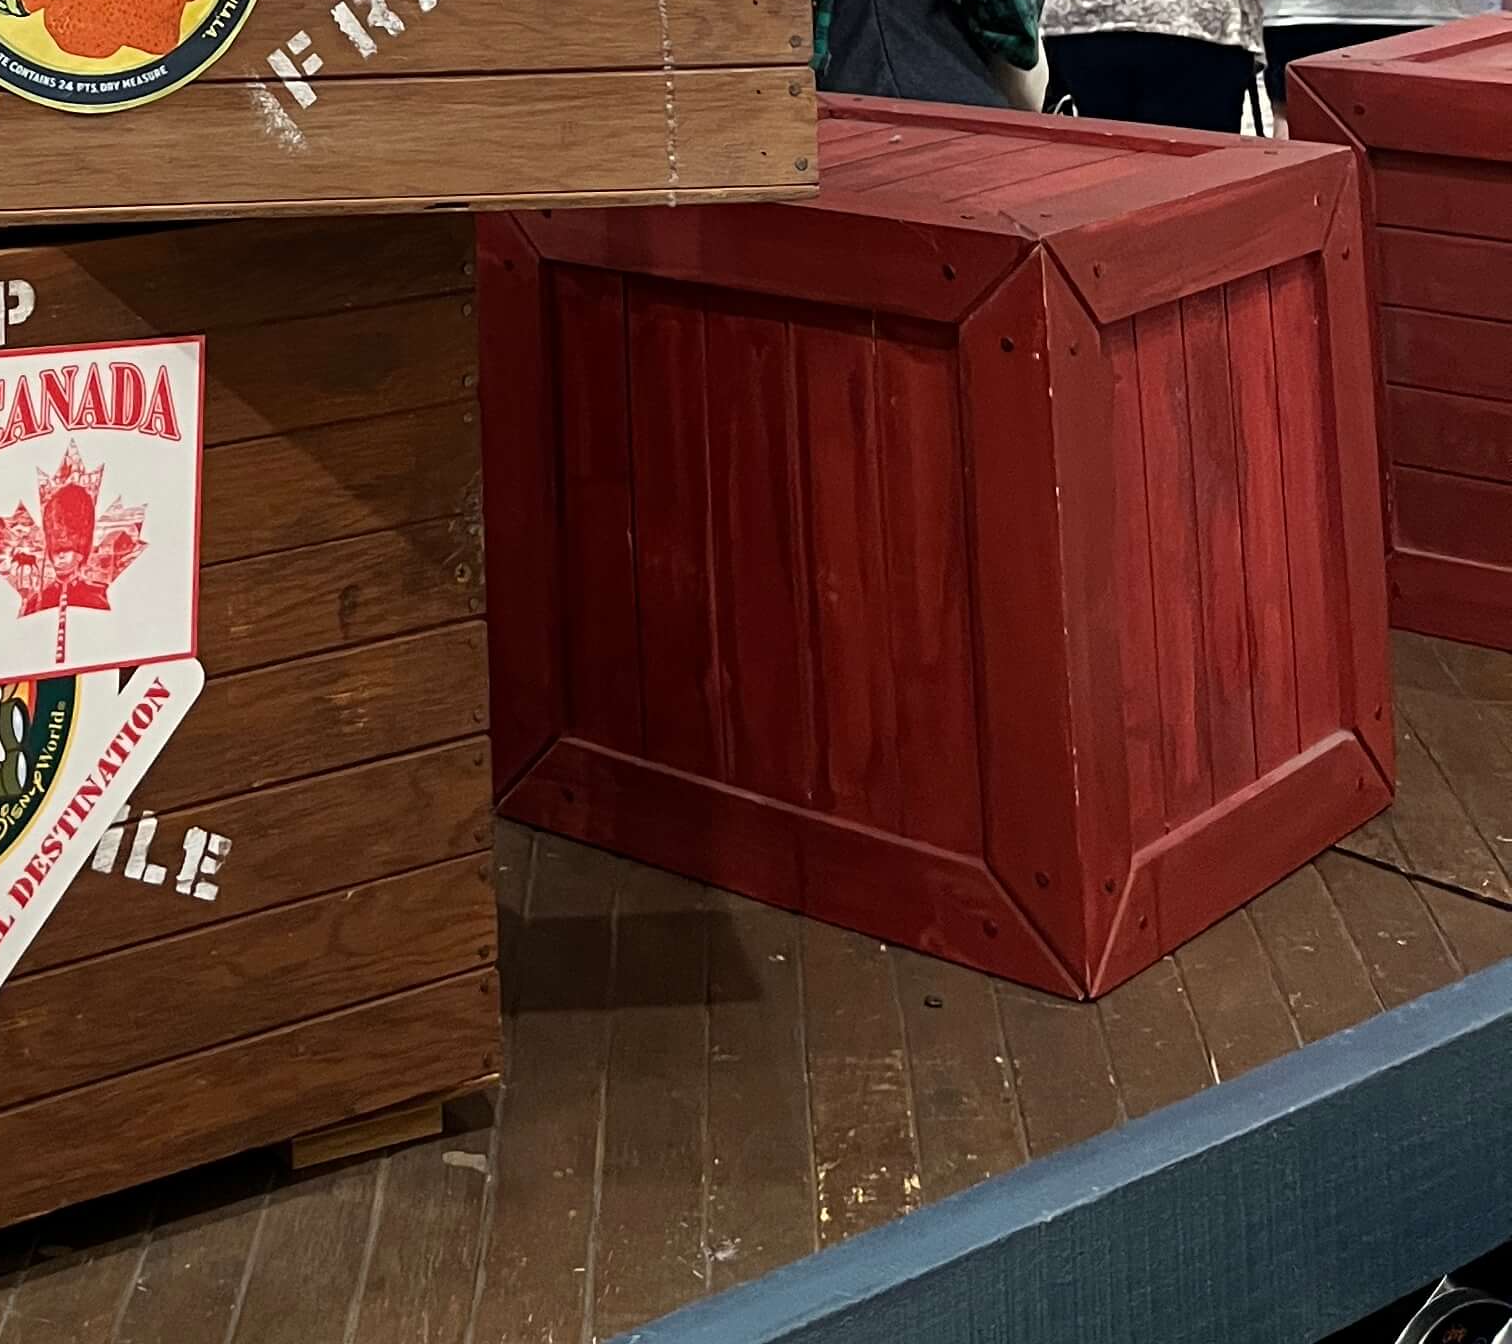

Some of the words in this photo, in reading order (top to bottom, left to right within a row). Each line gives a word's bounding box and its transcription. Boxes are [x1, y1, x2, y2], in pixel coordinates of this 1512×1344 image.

[9, 61, 57, 88] CONTAINS
[57, 79, 74, 91] 24
[99, 80, 120, 92] DRY
[121, 64, 169, 89] MEASURE
[7, 676, 172, 911] DESTINATION
